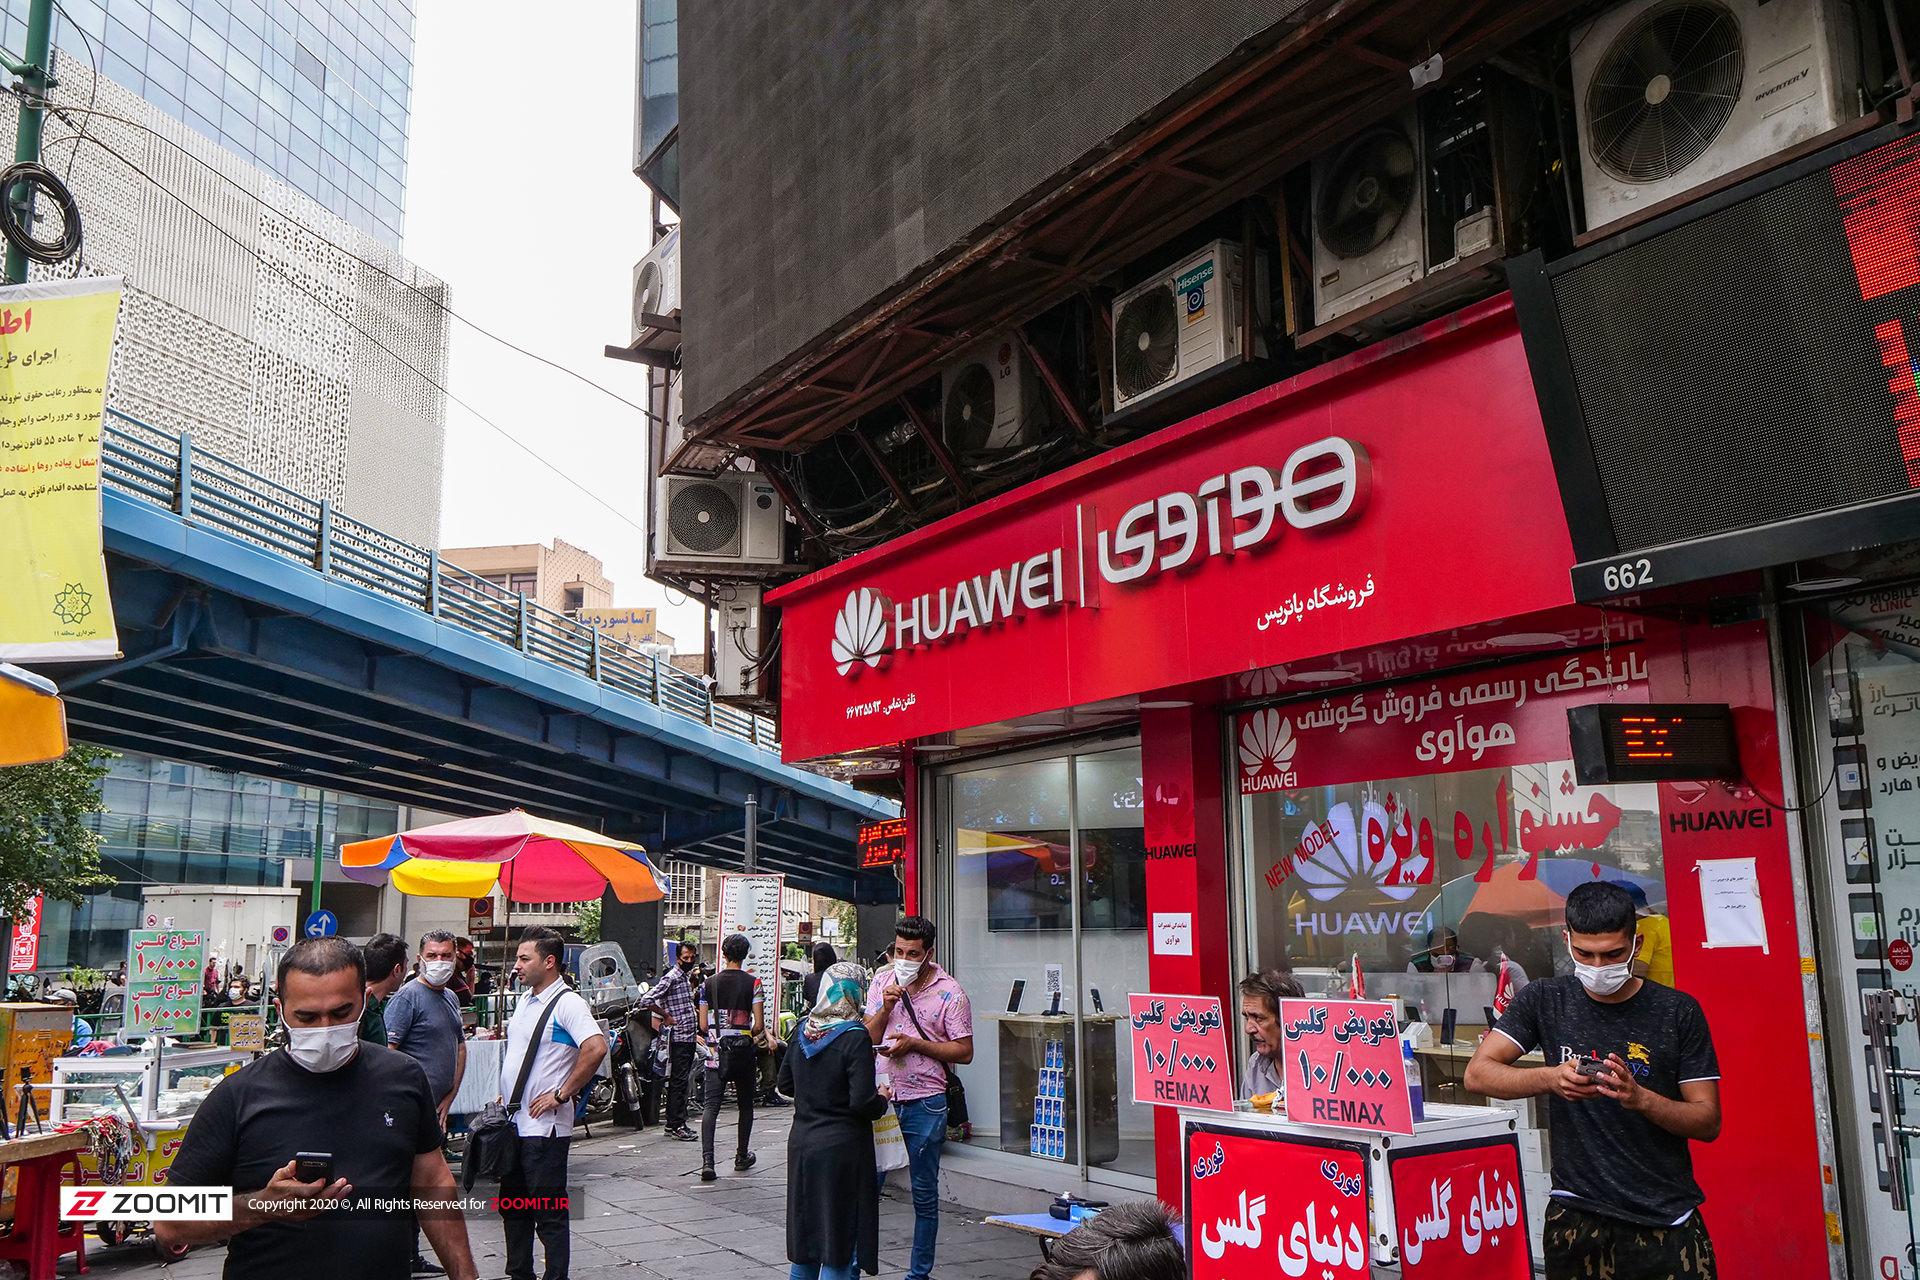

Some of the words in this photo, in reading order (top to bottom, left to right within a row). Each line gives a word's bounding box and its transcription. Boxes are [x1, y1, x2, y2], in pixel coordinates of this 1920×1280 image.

[1177, 265, 1214, 292] Hisense
[22, 348, 57, 367] اجرای
[1000, 366, 1011, 379] LG
[45, 388, 65, 398] رعایت
[68, 385, 92, 397] منظور
[95, 386, 103, 394] به
[36, 413, 55, 423] راحت
[56, 412, 74, 422] مرور
[83, 411, 101, 421] عبور
[24, 436, 42, 450] قانون
[58, 434, 75, 443] ماده
[55, 458, 72, 470] پیاده
[75, 458, 98, 470] اشغال
[18, 489, 27, 497] به
[47, 482, 65, 496] اقدام
[67, 482, 97, 492] مشاهده
[1603, 558, 1654, 592] 662
[894, 546, 1065, 652] HUAWEI
[1306, 573, 1375, 610] فروشگاه
[1870, 586, 1920, 605] MOBILE
[1256, 592, 1304, 631] پاتریس
[1870, 598, 1913, 614] CLINIC
[901, 692, 916, 712] تلفن
[1373, 684, 1442, 726] فروش
[1449, 679, 1526, 709] رسمی
[1297, 694, 1367, 733] گوشی
[1877, 757, 1887, 771] و
[1241, 771, 1298, 793] HUAWEI
[1879, 777, 1912, 796] هارد
[1669, 807, 1773, 834] HUAWEI
[1367, 791, 1436, 886] ویژه
[1144, 842, 1198, 861] HUAWEI
[1264, 854, 1295, 892] NEW
[1294, 818, 1341, 866] MODEL
[1294, 910, 1434, 936] HUAWEI
[134, 934, 167, 951] گلس
[168, 934, 202, 950] انواع
[131, 984, 164, 1001] گلس
[165, 983, 198, 1001] انواع
[1132, 1000, 1165, 1030] گلس
[1170, 1001, 1221, 1035] تعویض
[1284, 1002, 1328, 1040] گلس
[148, 1024, 176, 1034] تومان
[1333, 1007, 1395, 1046] تعویض
[1143, 1037, 1216, 1077] ۱۰/۰۰۰
[1298, 1049, 1392, 1094] ۱۰/۰۰۰
[1153, 1079, 1211, 1105] REMAX
[1312, 1097, 1386, 1126] REMAX
[1193, 1141, 1224, 1179] فوری
[1321, 1158, 1361, 1198] فوری
[1404, 1177, 1451, 1266] گلس
[1462, 1169, 1519, 1255] دنیای
[1201, 1189, 1266, 1260] گلس
[1277, 1200, 1366, 1280] دنیای
